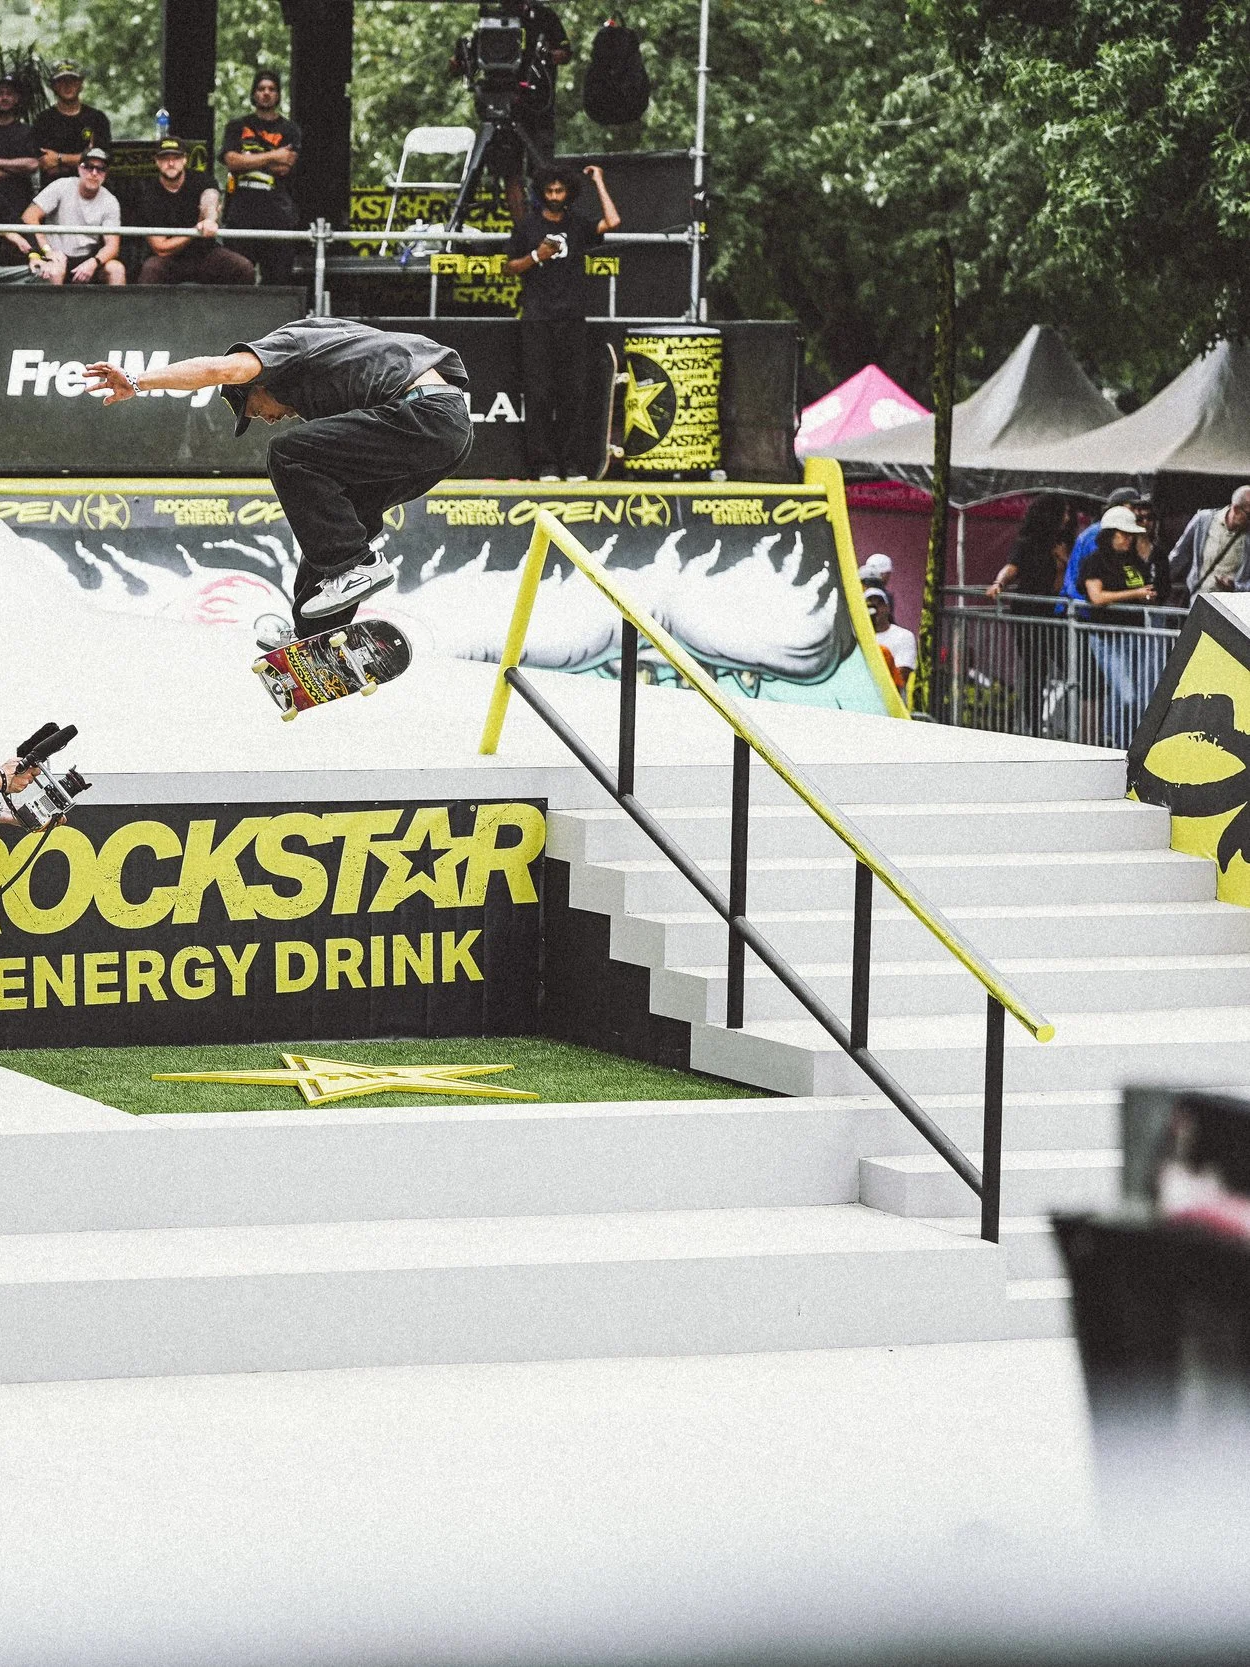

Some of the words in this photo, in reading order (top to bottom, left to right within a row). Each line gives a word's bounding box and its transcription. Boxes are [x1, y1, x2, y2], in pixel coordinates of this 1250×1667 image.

[153, 498, 229, 514] ROCKSTAR
[426, 499, 500, 514] ROCKSTAR
[691, 498, 764, 514] ROCKSTAR
[772, 498, 832, 525] OP
[174, 511, 236, 526] ENERGY
[446, 511, 507, 526] ENERGY
[712, 510, 770, 525] ENERGY
[274, 928, 485, 994] DRINK
